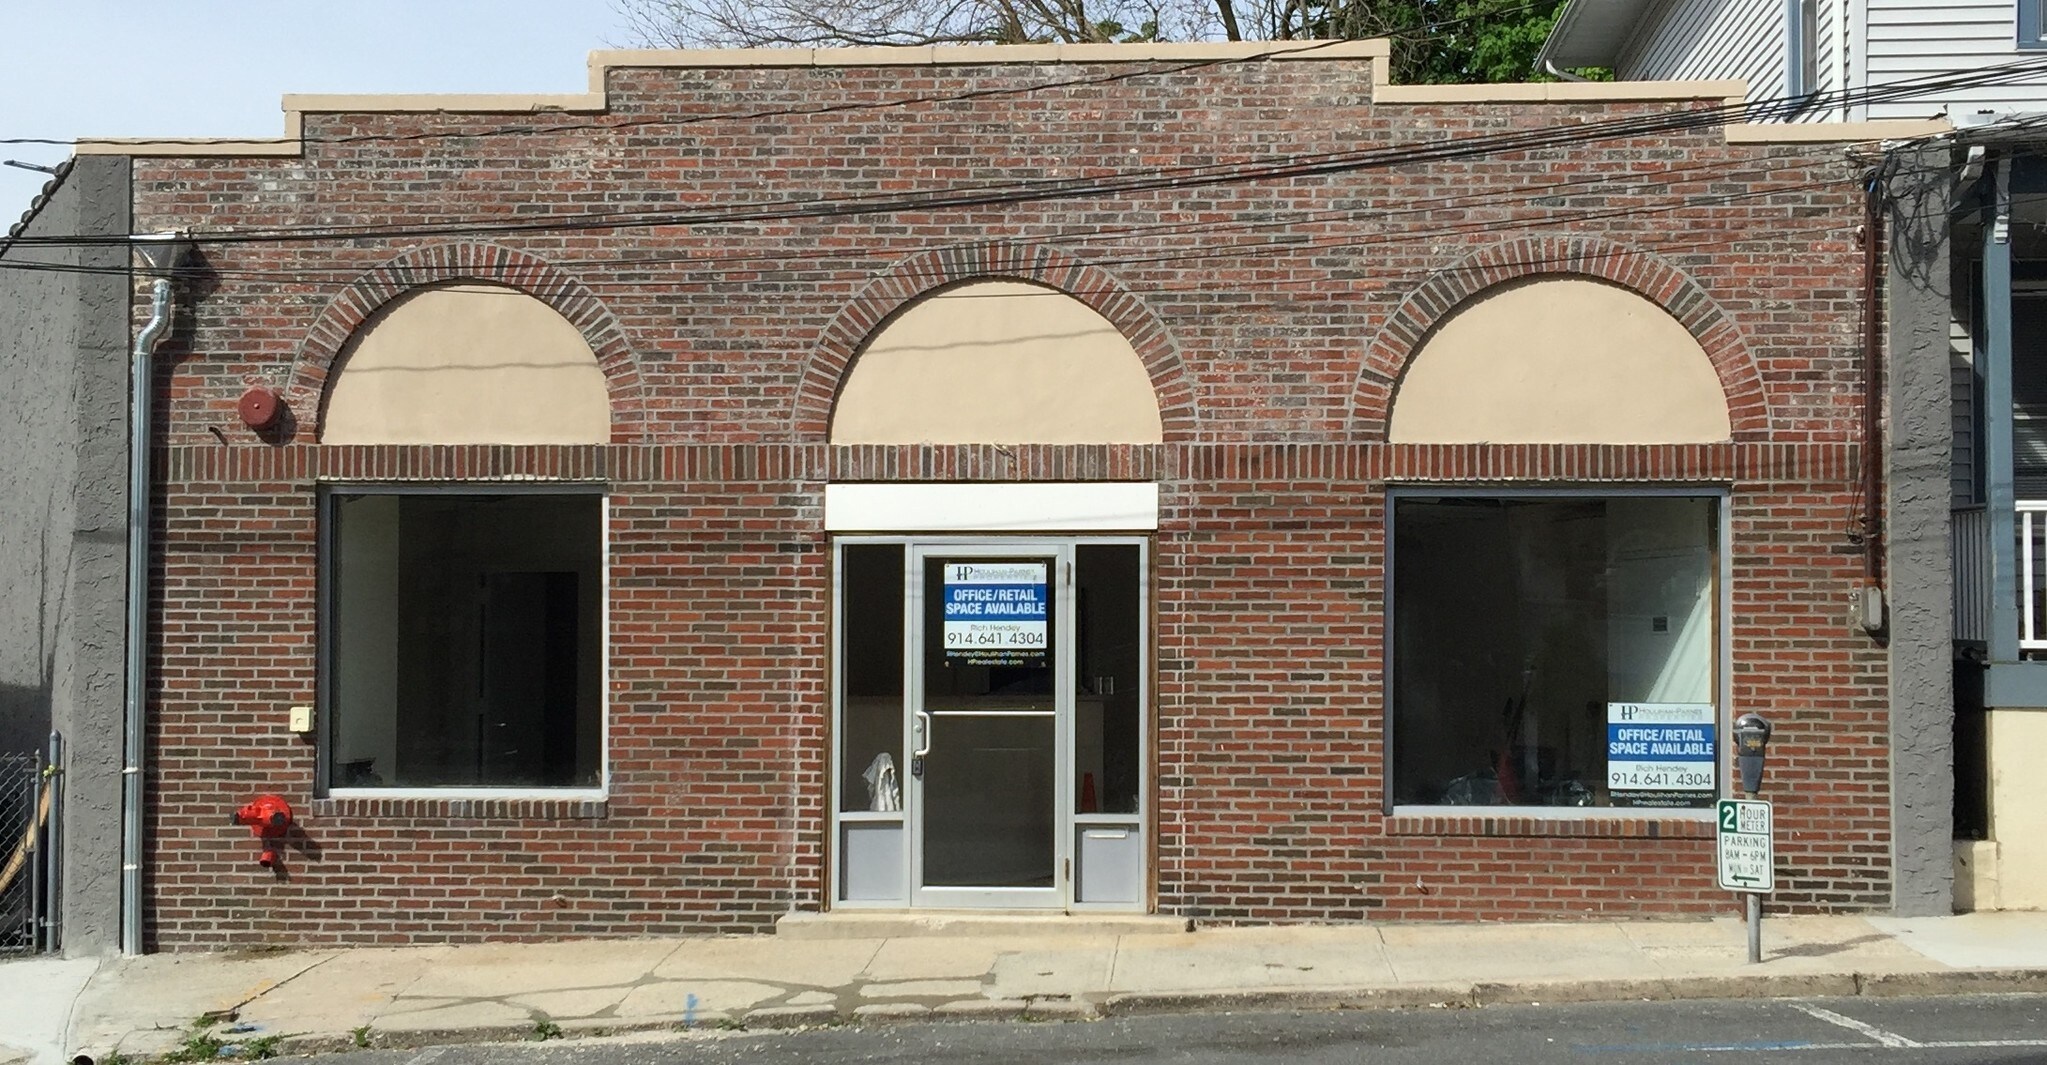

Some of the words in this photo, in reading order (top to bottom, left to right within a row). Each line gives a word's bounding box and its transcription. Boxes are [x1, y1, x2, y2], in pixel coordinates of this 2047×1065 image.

[953, 589, 1038, 601] OFFICE/RETAIL
[946, 602, 982, 614] SPACE
[984, 602, 1046, 614] AVAILABLE
[947, 632, 1043, 644] 914.641.4304
[1617, 728, 1706, 741] OFFICE/RETAIL
[1609, 742, 1648, 755] SPACE
[1650, 742, 1714, 755] AVAILABLE
[1611, 772, 1712, 785] 914.641.4304
[1722, 805, 1736, 830] 2
[1739, 808, 1766, 820] HOUR
[1740, 820, 1766, 832] METER
[1724, 835, 1766, 849] PARKING
[1725, 849, 1740, 860] 8AM
[1750, 851, 1766, 862] 6PM
[1728, 863, 1742, 873] MN
[1750, 864, 1764, 875] SAT
